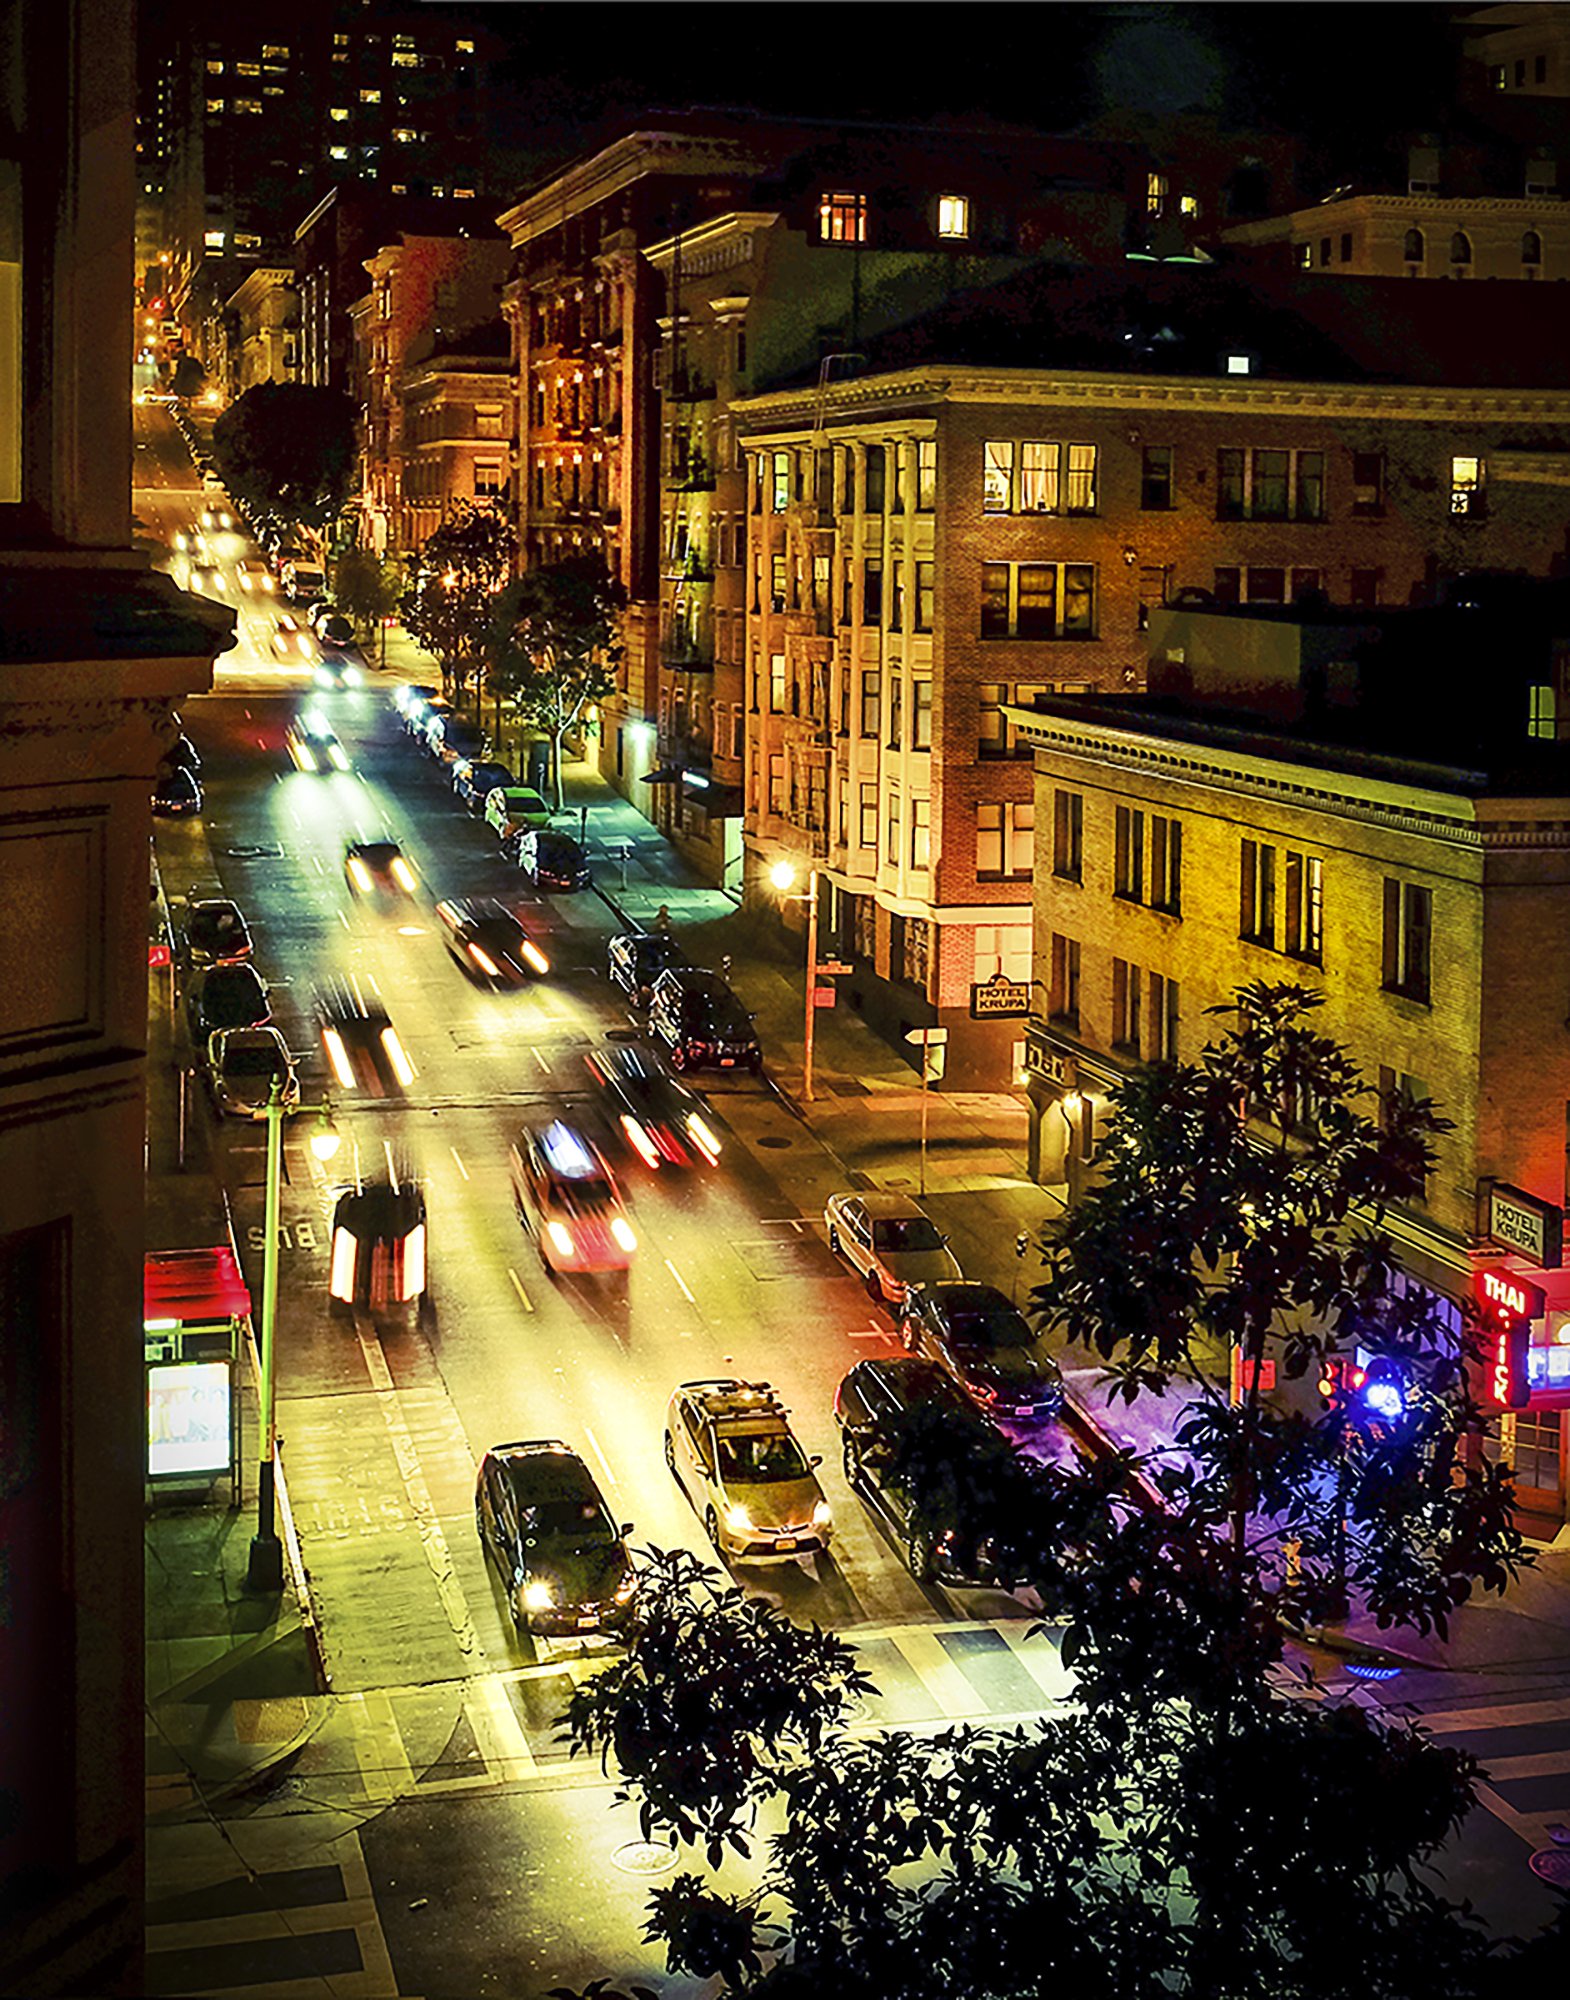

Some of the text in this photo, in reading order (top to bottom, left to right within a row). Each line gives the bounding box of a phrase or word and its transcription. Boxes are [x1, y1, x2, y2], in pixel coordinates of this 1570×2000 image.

[979, 988, 1024, 998] HOTEL
[979, 1000, 1025, 1009] KRUPA
[1496, 1203, 1538, 1235] HOTEL
[1496, 1219, 1538, 1251] KRUPA
[1483, 1272, 1525, 1315] THAI
